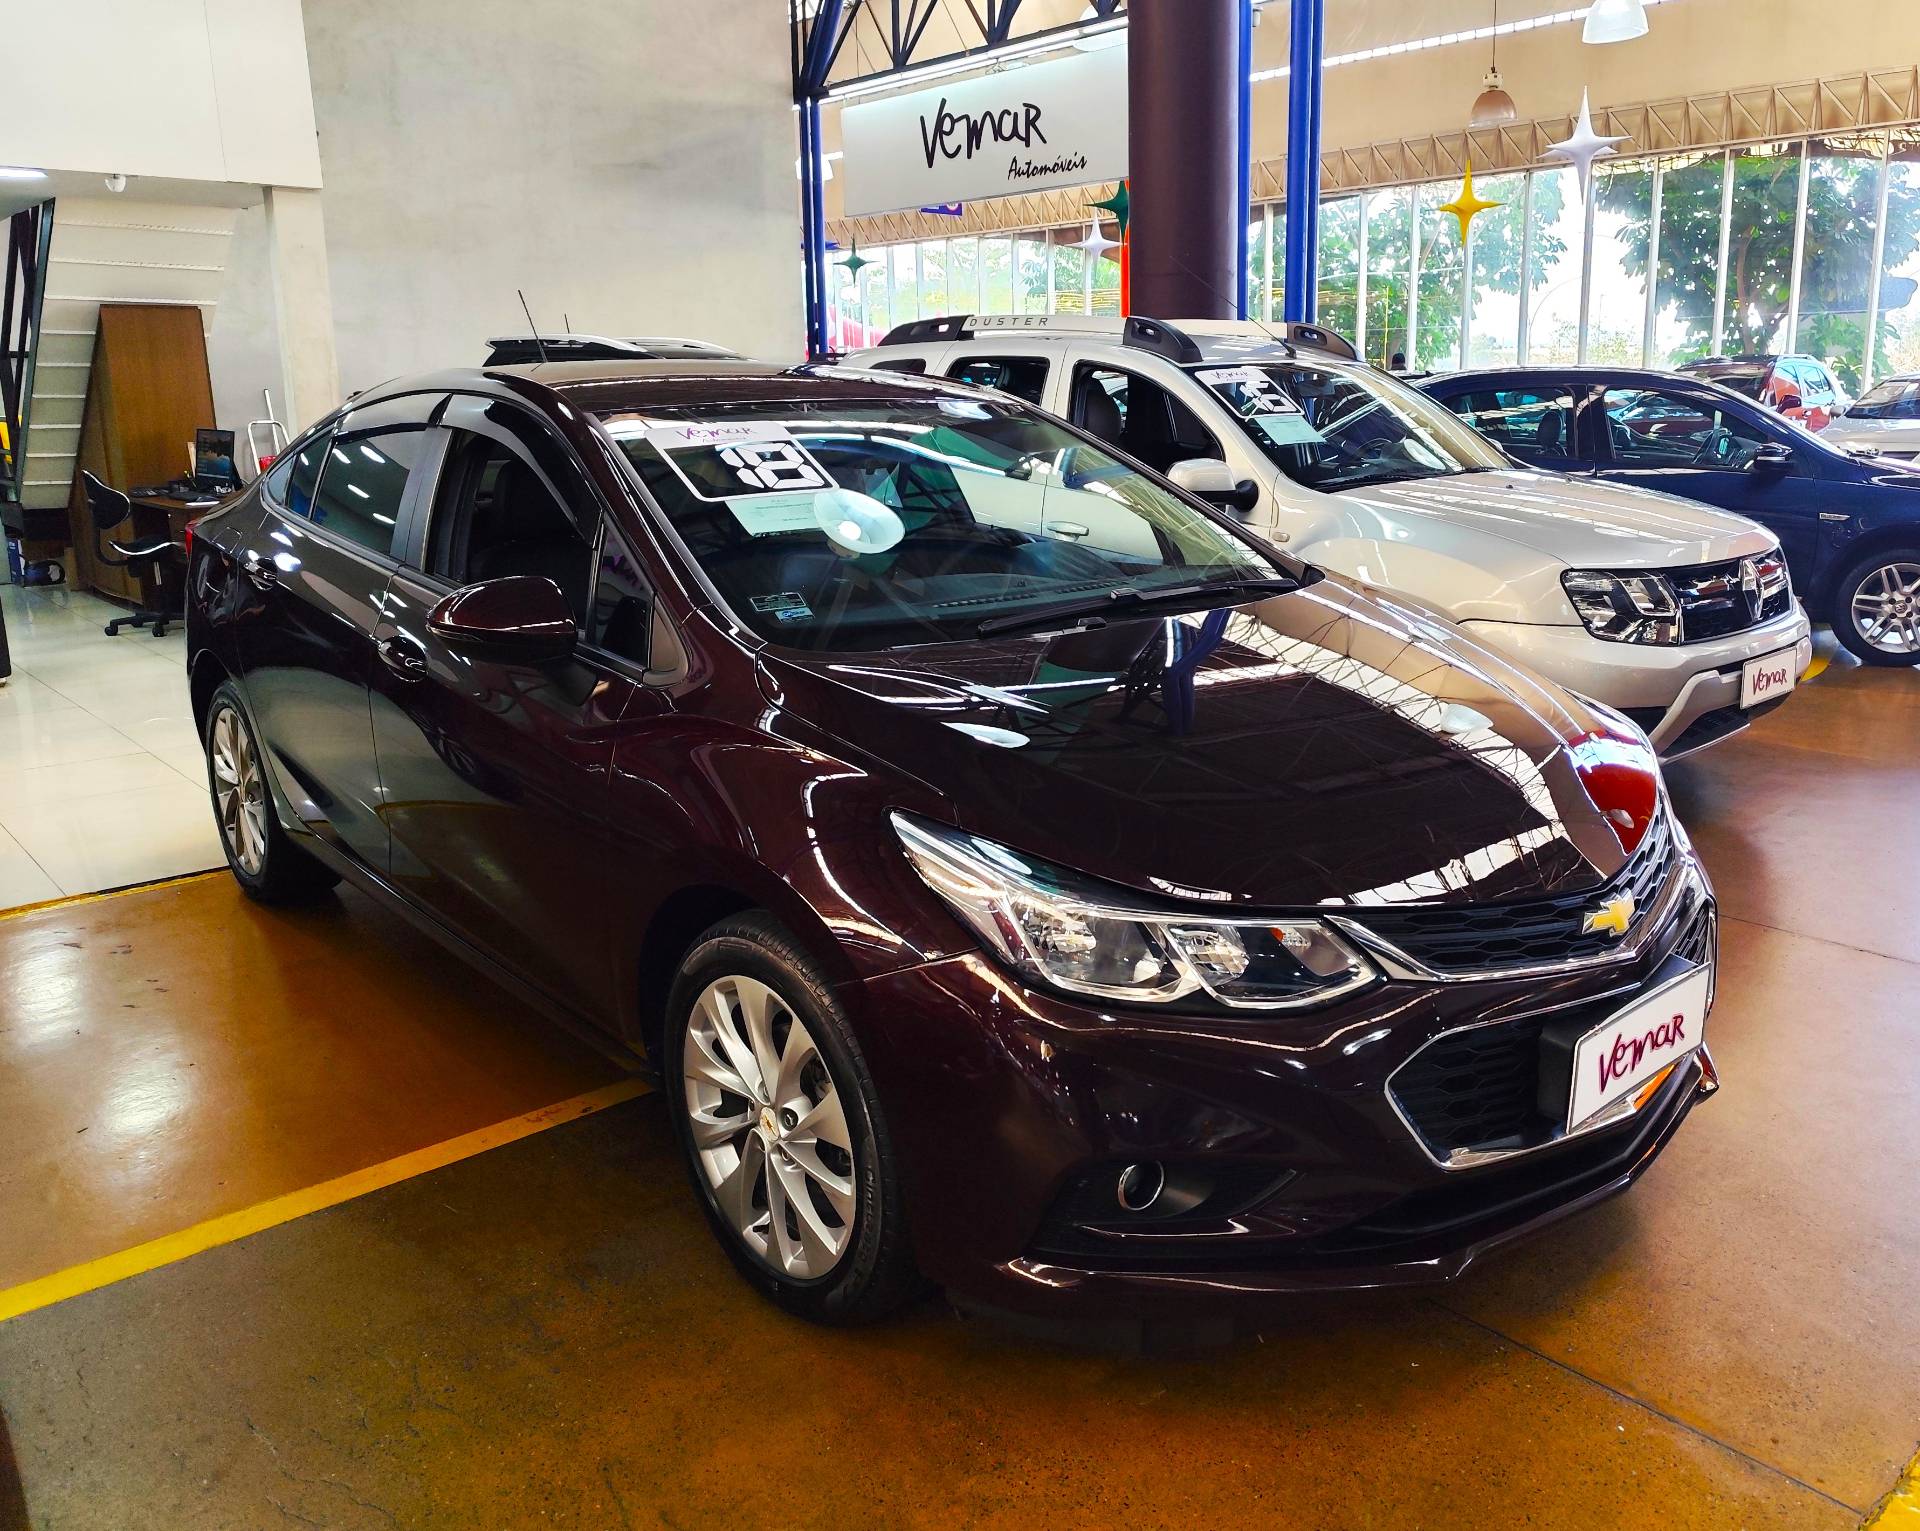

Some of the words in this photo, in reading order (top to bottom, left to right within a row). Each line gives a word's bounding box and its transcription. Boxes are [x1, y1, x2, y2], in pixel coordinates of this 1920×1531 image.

[1007, 151, 1088, 180] Automóveis
[969, 316, 1049, 328] DUSTER
[719, 442, 825, 489] 18
